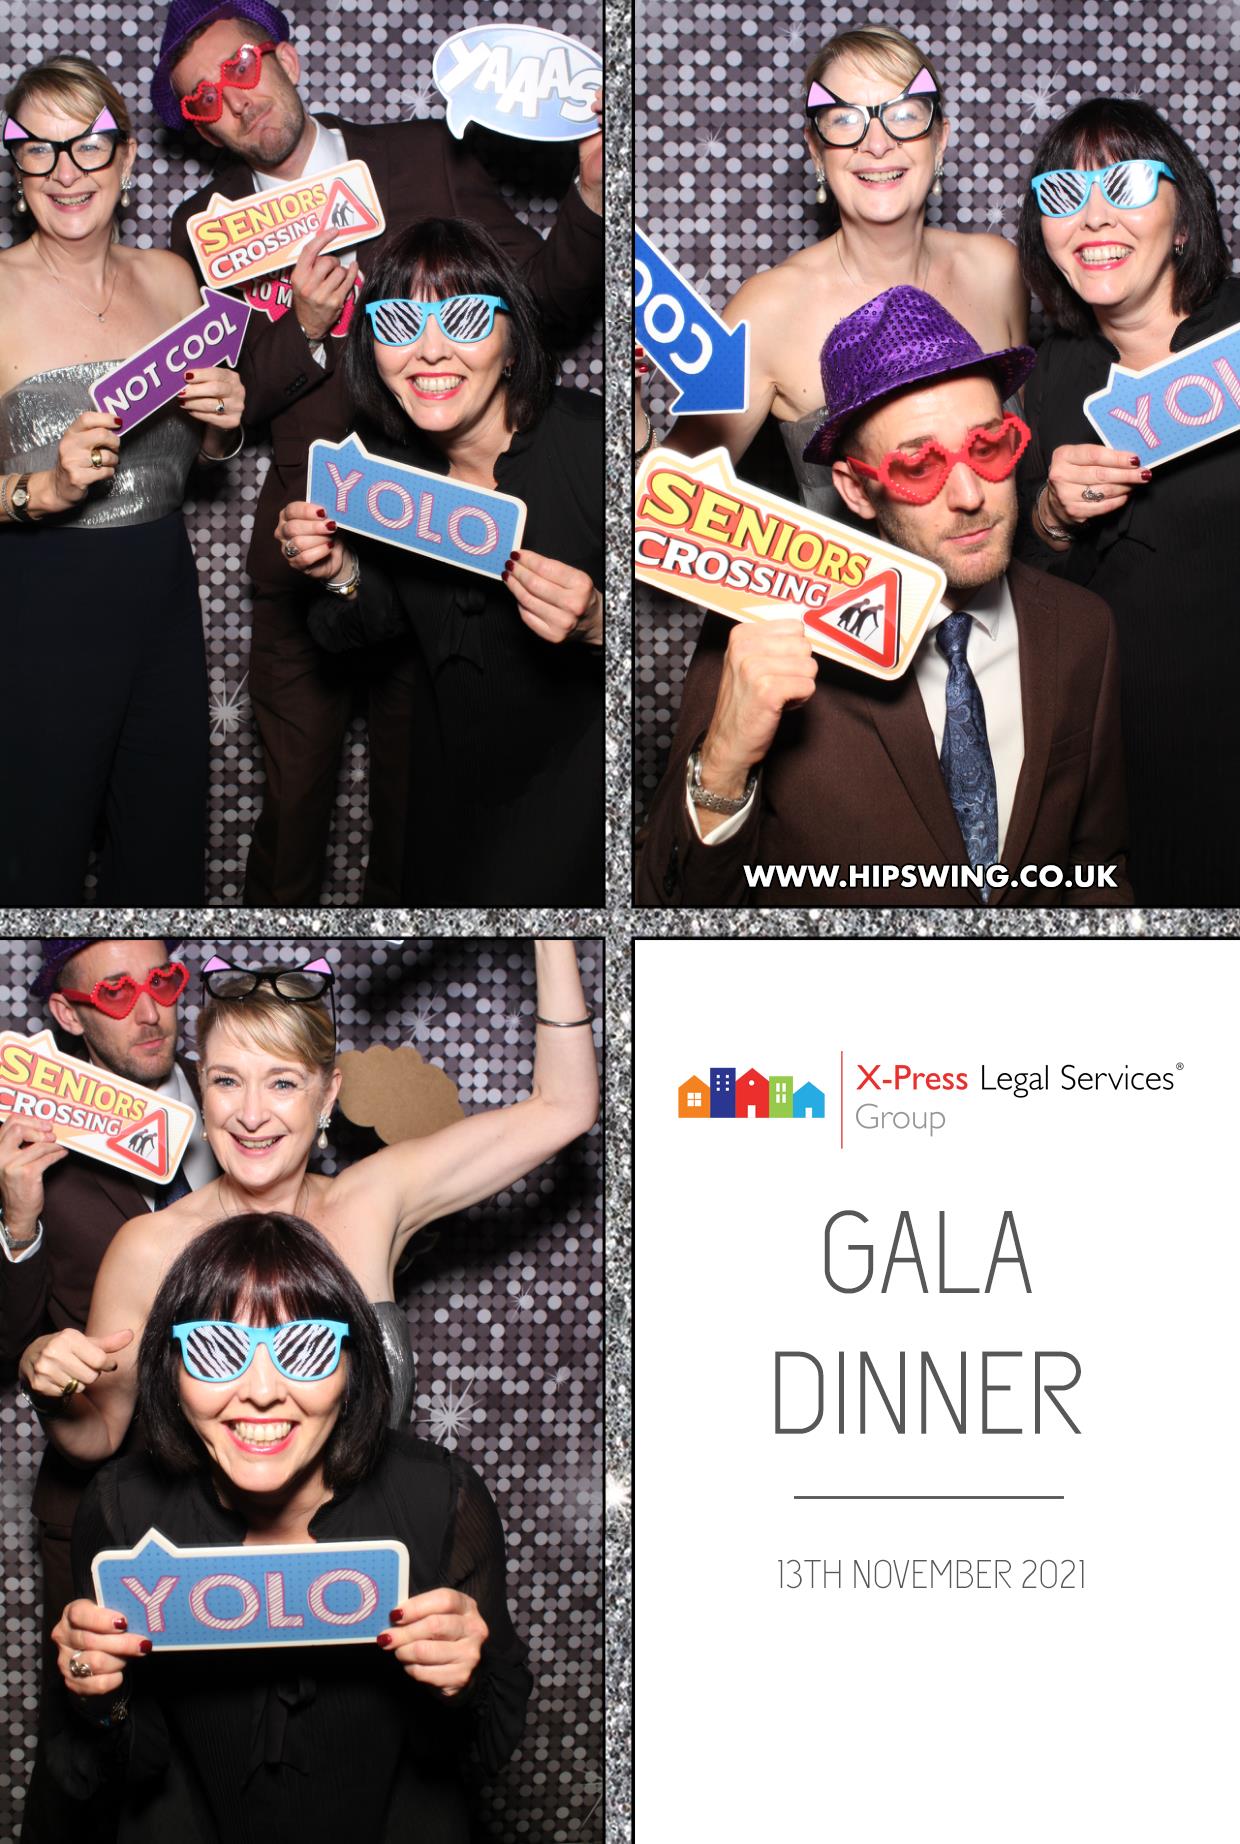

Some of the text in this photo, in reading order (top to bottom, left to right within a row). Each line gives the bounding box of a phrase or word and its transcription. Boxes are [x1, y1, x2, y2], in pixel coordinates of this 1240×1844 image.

[438, 38, 603, 123] YAAAS
[197, 183, 328, 255] SENIORS
[210, 213, 320, 280] CROSSING
[102, 311, 238, 417] NOT COOL
[325, 461, 499, 556] YOLO
[639, 470, 870, 588] SENIORS
[635, 530, 830, 608] CROSSING
[0, 1046, 147, 1121] SENIORS
[0, 1086, 122, 1136] CROSSING
[120, 1568, 380, 1632] YOLO
